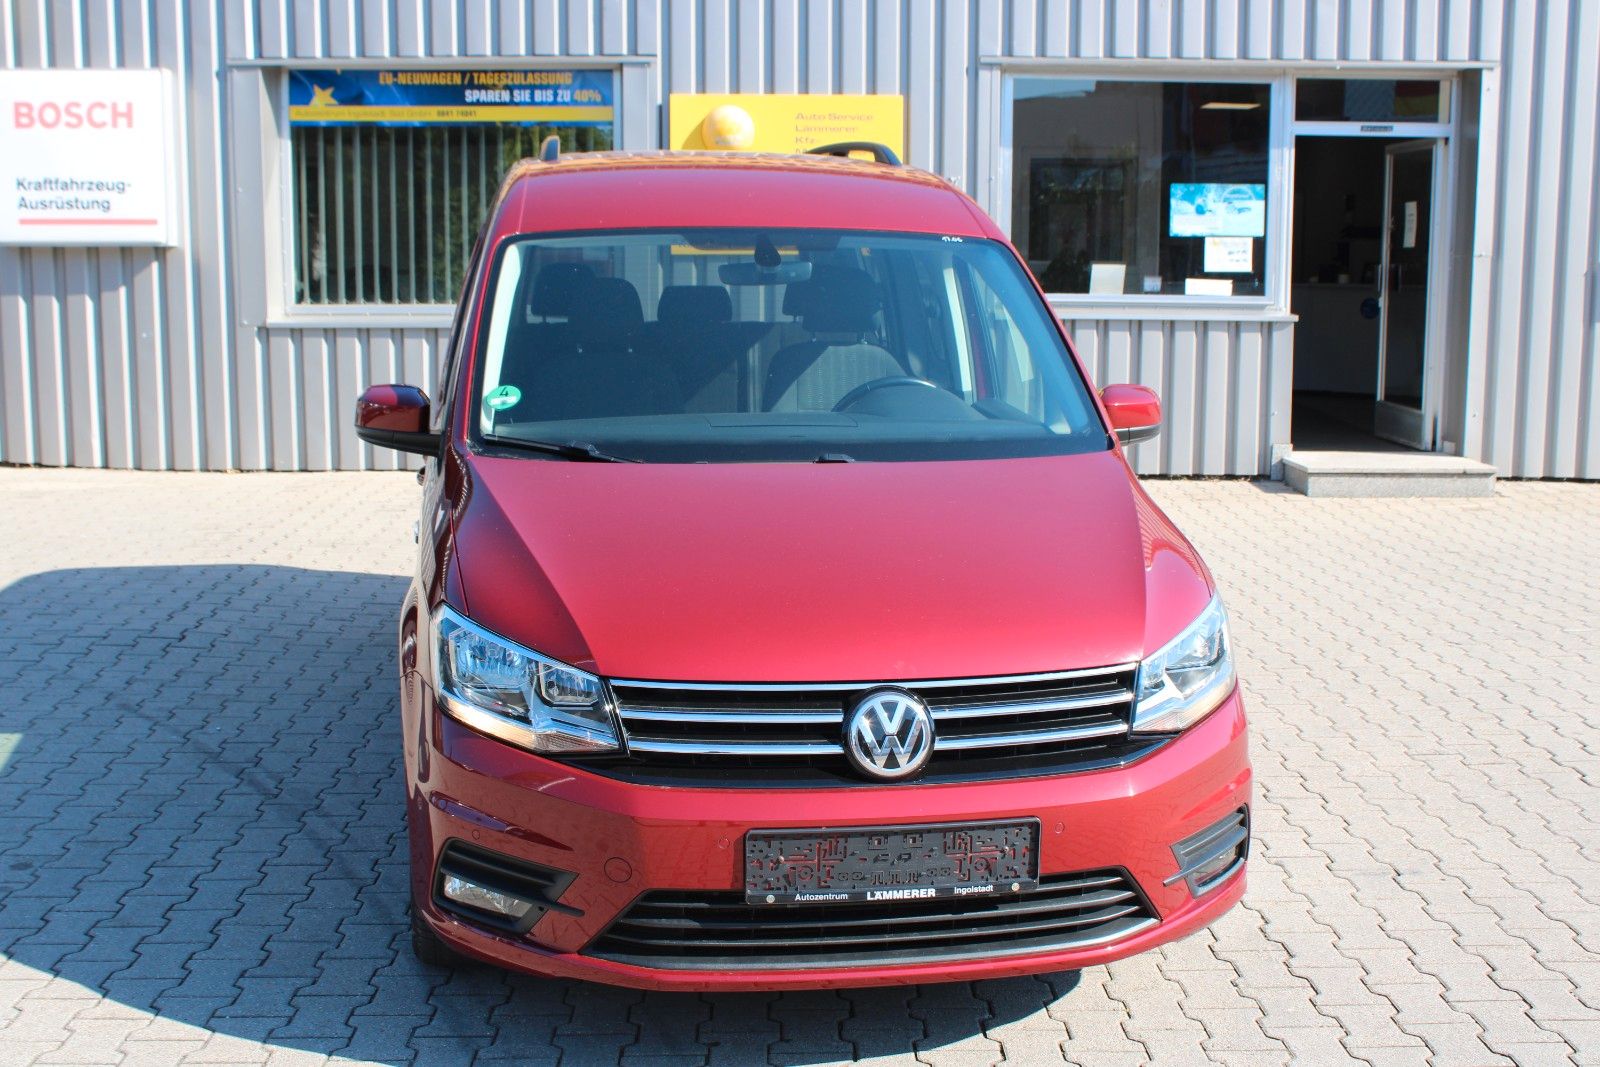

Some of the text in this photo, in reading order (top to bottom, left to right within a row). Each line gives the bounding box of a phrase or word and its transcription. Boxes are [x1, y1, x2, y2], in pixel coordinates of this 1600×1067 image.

[379, 71, 461, 85] EU-NEUWAGEN
[473, 71, 573, 85] TAGESZULASSUNG
[464, 89, 601, 103] SPAREN SIE BIS ZU 40%
[14, 101, 134, 129] BOSCH
[795, 112, 874, 122] Auto Service
[16, 177, 132, 194] Kraftfahrzeug-
[18, 196, 111, 212] Ausrüstung
[499, 386, 511, 397] 4
[795, 884, 994, 901] Autozentrum LÄMMERER Ingolstadt
